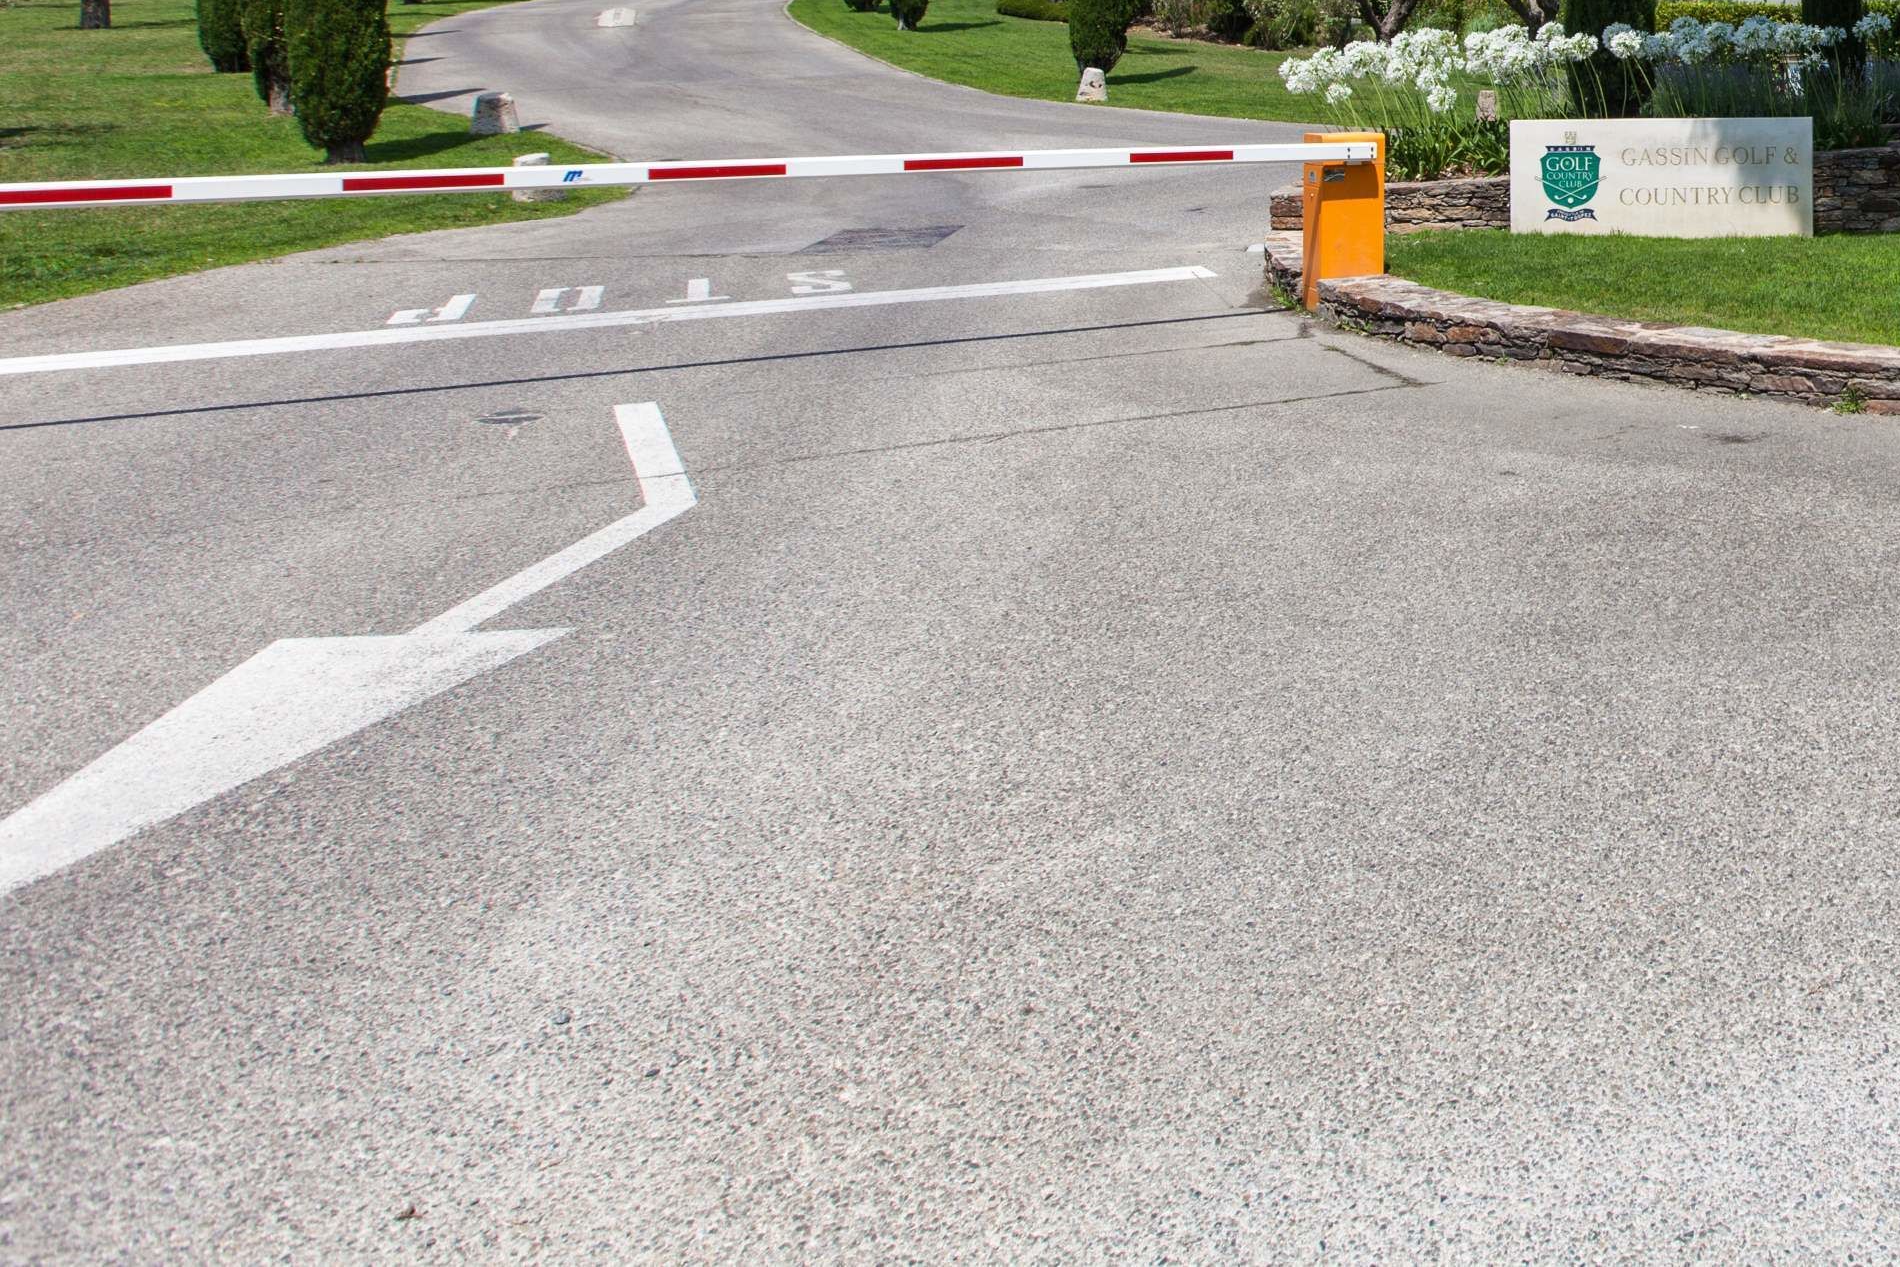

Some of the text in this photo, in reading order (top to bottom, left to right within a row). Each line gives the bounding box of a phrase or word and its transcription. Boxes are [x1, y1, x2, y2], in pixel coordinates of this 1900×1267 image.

[1546, 156, 1593, 172] GOLF
[1714, 146, 1777, 166] GOLF
[1783, 146, 1799, 165] &
[1546, 171, 1594, 182] COUNTRY
[1558, 179, 1583, 188] CLUB
[1619, 185, 1800, 207] COUNTRY CLUB
[386, 269, 852, 326] STOP
